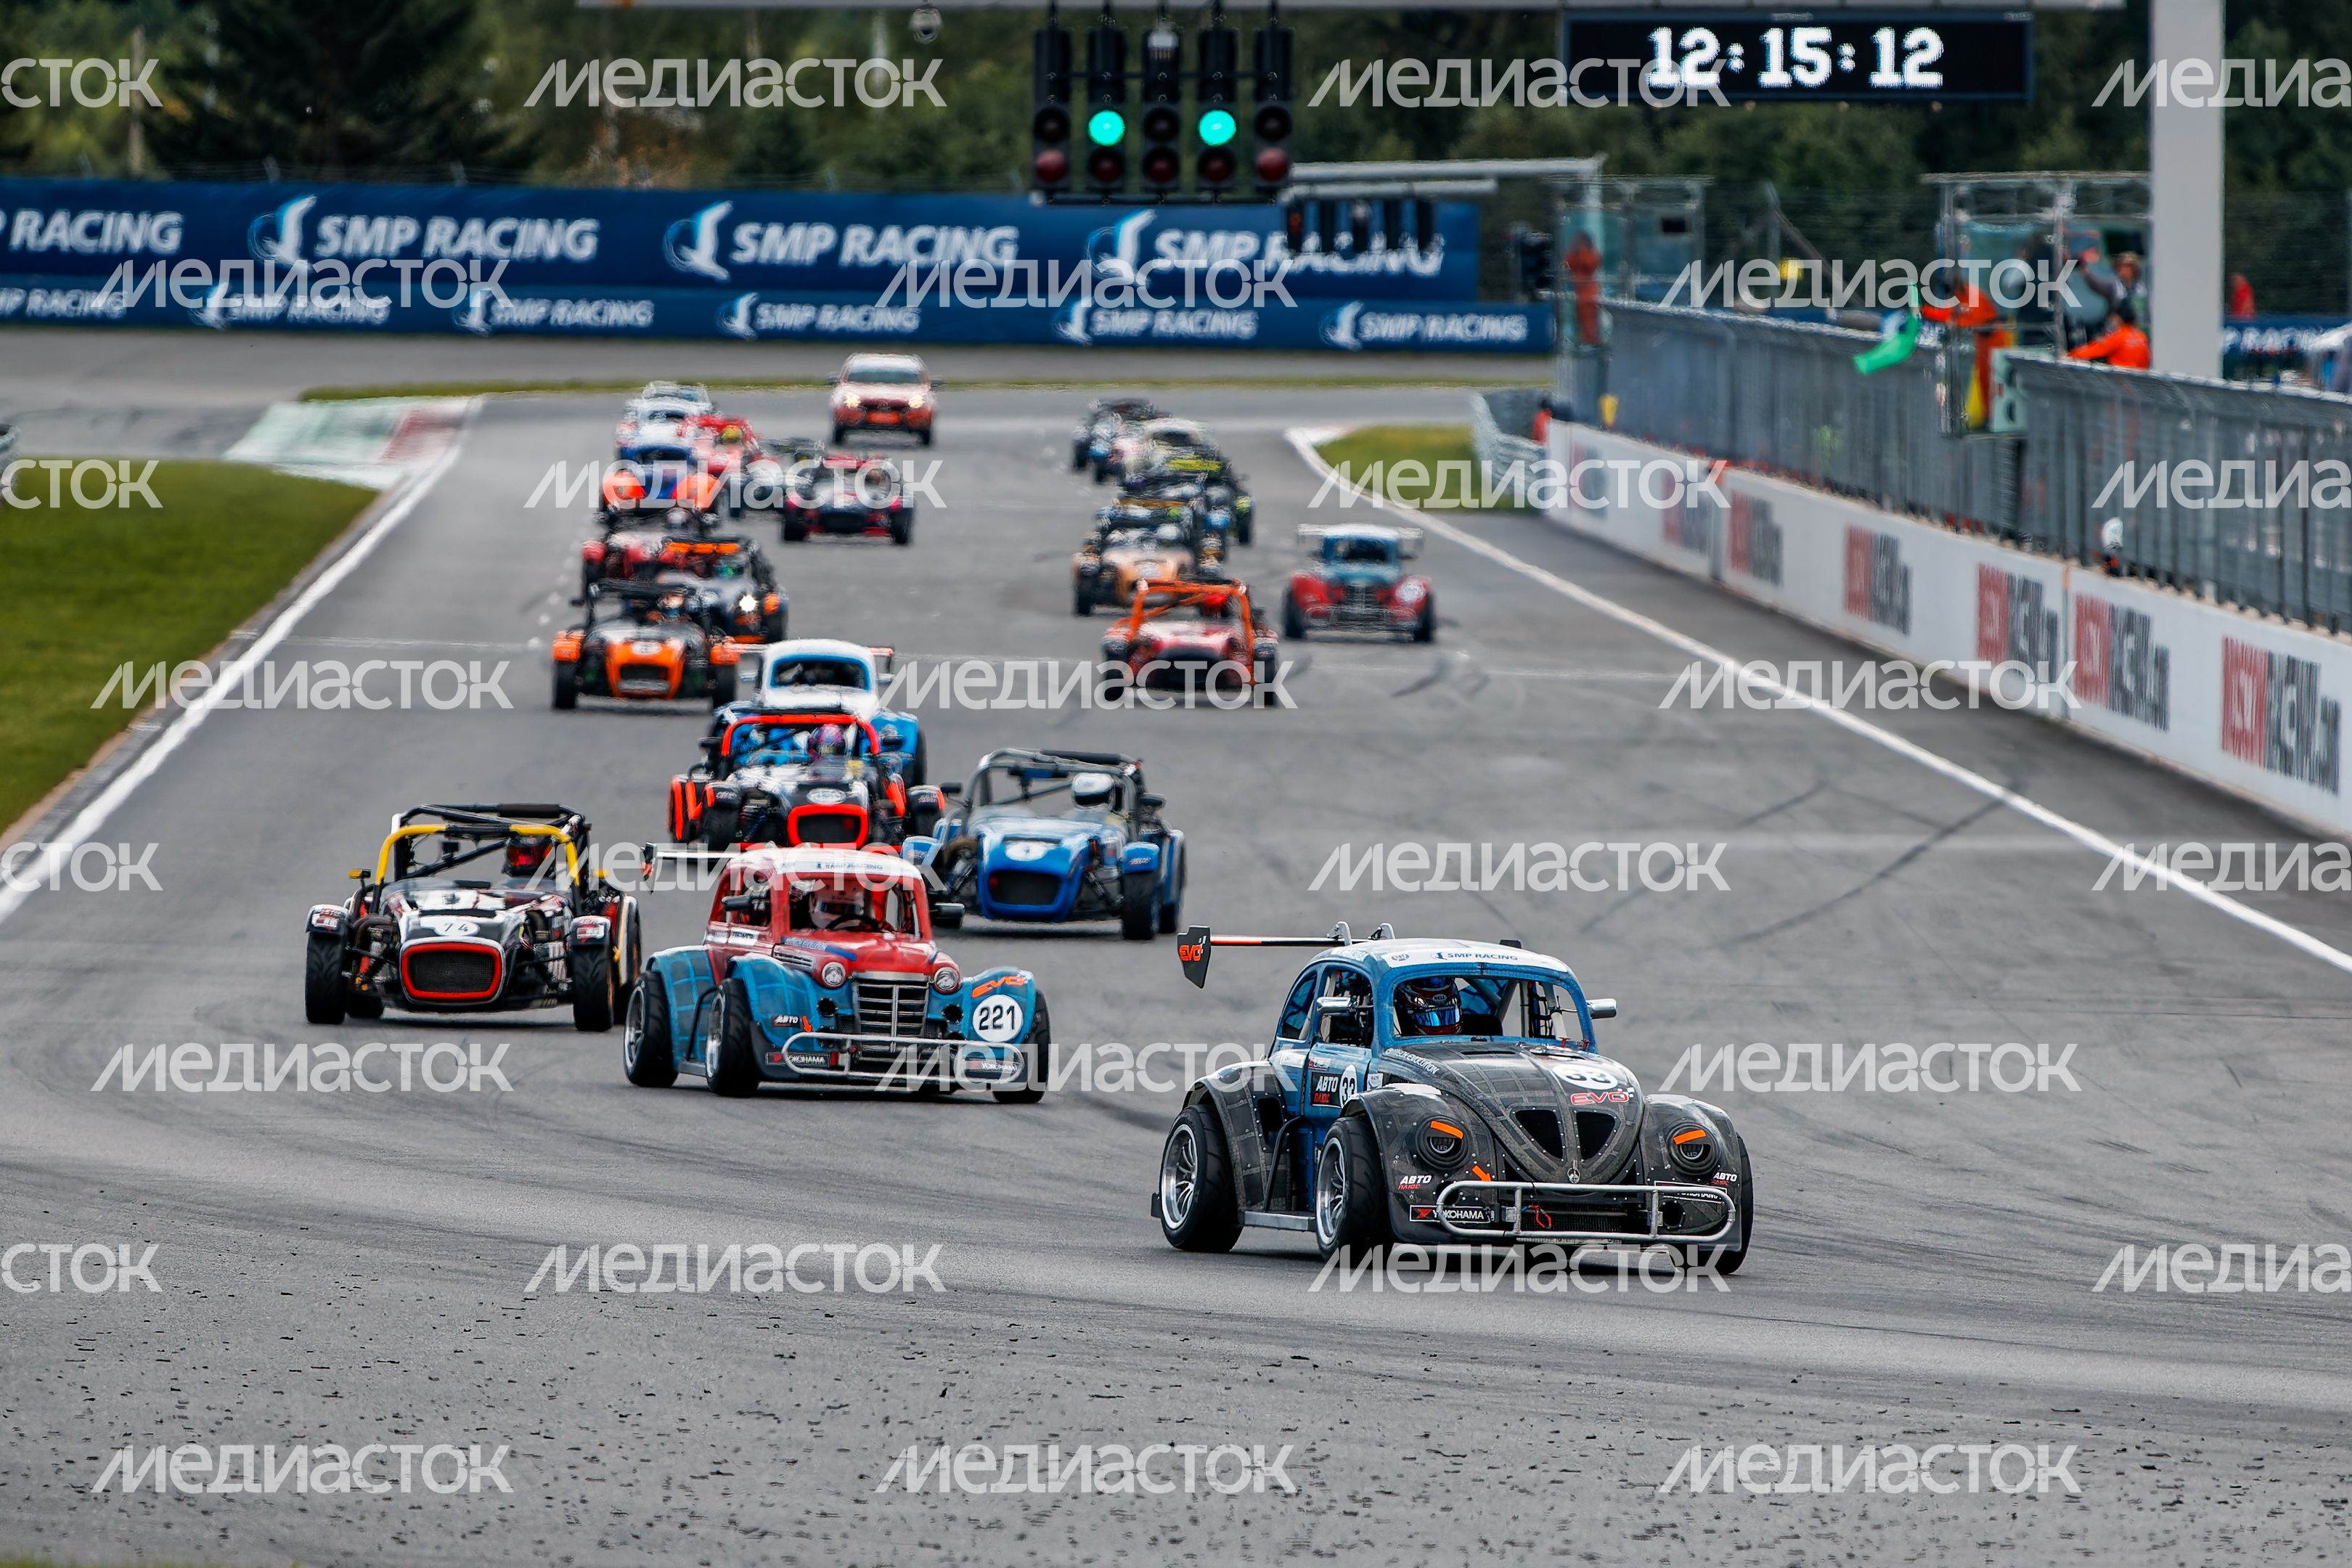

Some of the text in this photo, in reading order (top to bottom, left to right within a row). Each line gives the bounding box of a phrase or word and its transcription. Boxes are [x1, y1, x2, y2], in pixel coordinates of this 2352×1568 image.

[8, 208, 184, 255] RACING
[314, 215, 600, 262] SMP RACING
[730, 221, 1018, 269] SMP RACING
[1152, 229, 1260, 274] SMP
[25, 288, 128, 319] RACING
[550, 298, 655, 327] RACING
[756, 303, 921, 334] SMP RACING
[1090, 309, 1259, 339] SMP RACING
[1358, 311, 1529, 343] SMP RACING
[444, 923, 469, 932] 74
[1179, 944, 1202, 961] EVO
[971, 975, 1025, 998] EVO
[978, 1005, 1015, 1030] 221
[788, 1055, 825, 1064] OKOHAMA
[1406, 1053, 1440, 1074] EVOLUTION
[1315, 1076, 1339, 1093] АВТО
[1570, 1091, 1629, 1106] EVO
[1400, 1175, 1432, 1185] АВТО
[1713, 1172, 1738, 1182] АВТО
